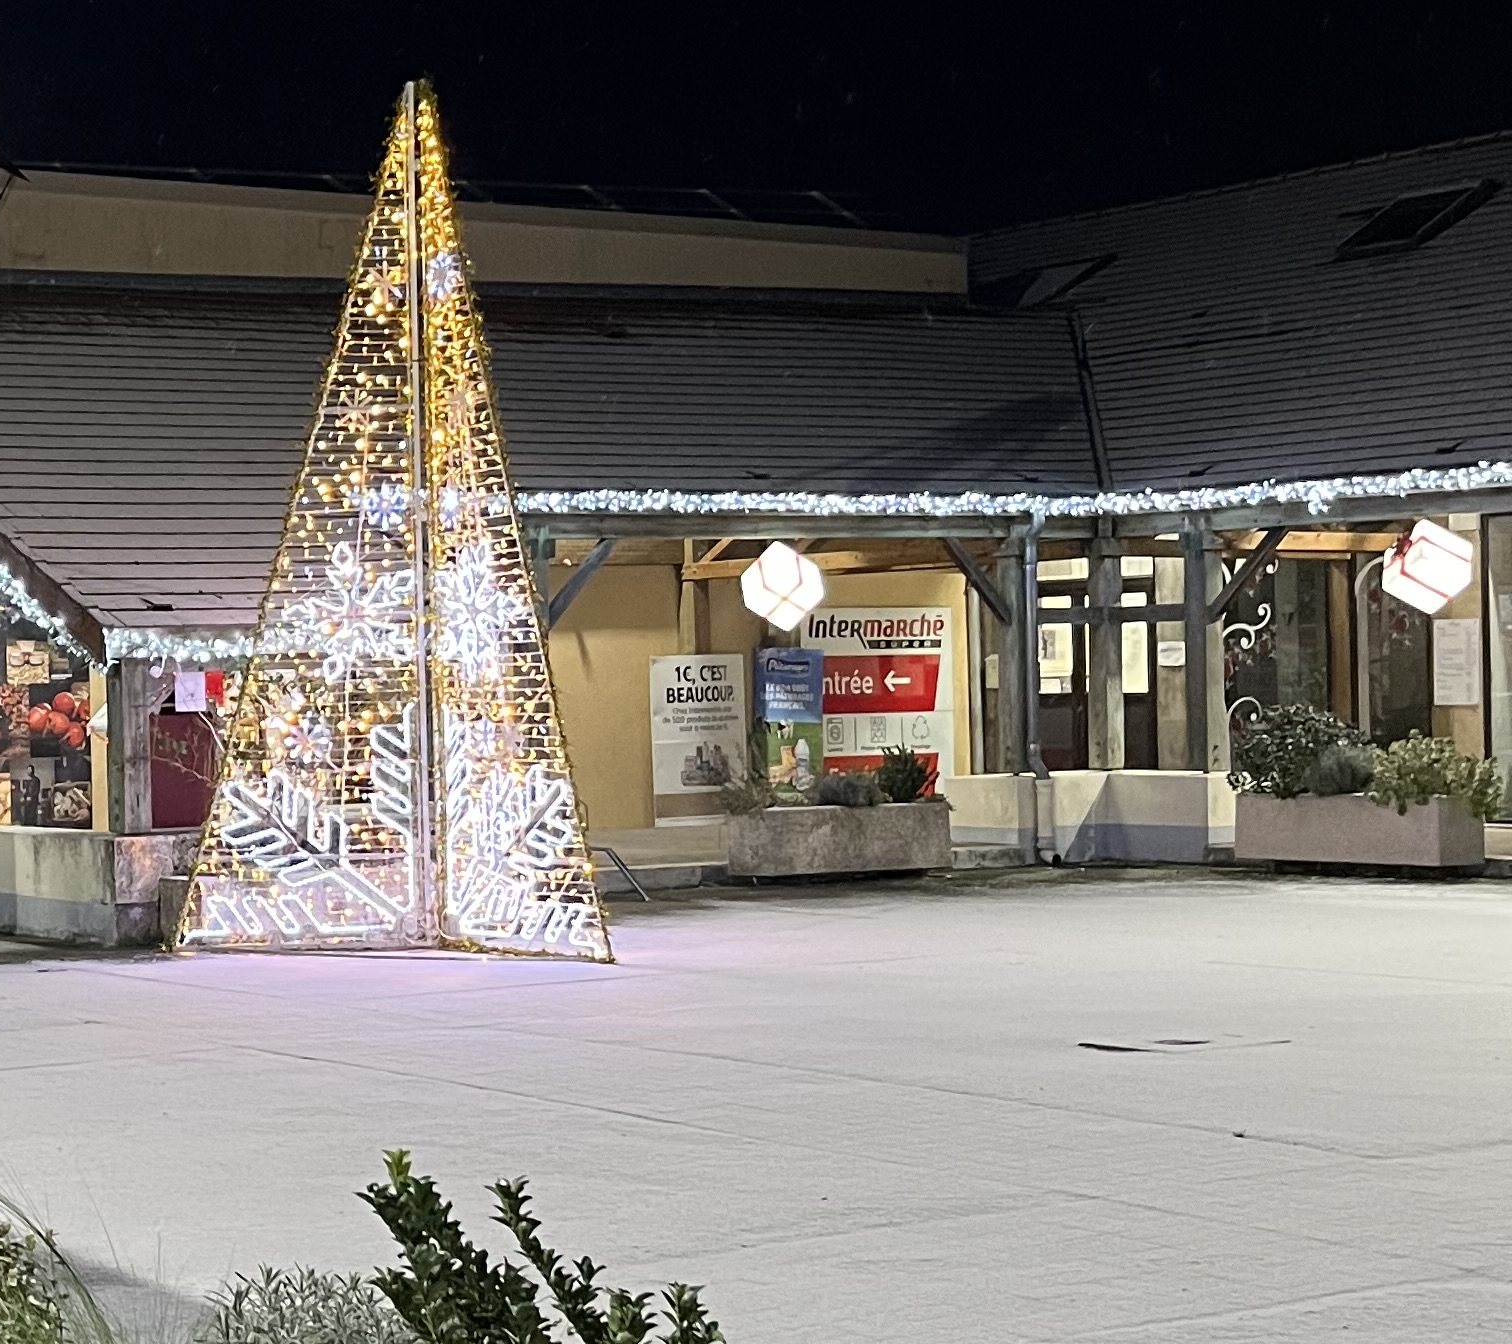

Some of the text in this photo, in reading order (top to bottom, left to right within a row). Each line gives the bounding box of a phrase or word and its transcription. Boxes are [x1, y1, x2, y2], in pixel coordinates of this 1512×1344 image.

[809, 613, 944, 649] Intermarché
[879, 640, 932, 648] SUPER
[699, 664, 727, 682] C'EST
[666, 685, 735, 704] BEAUCOUP.
